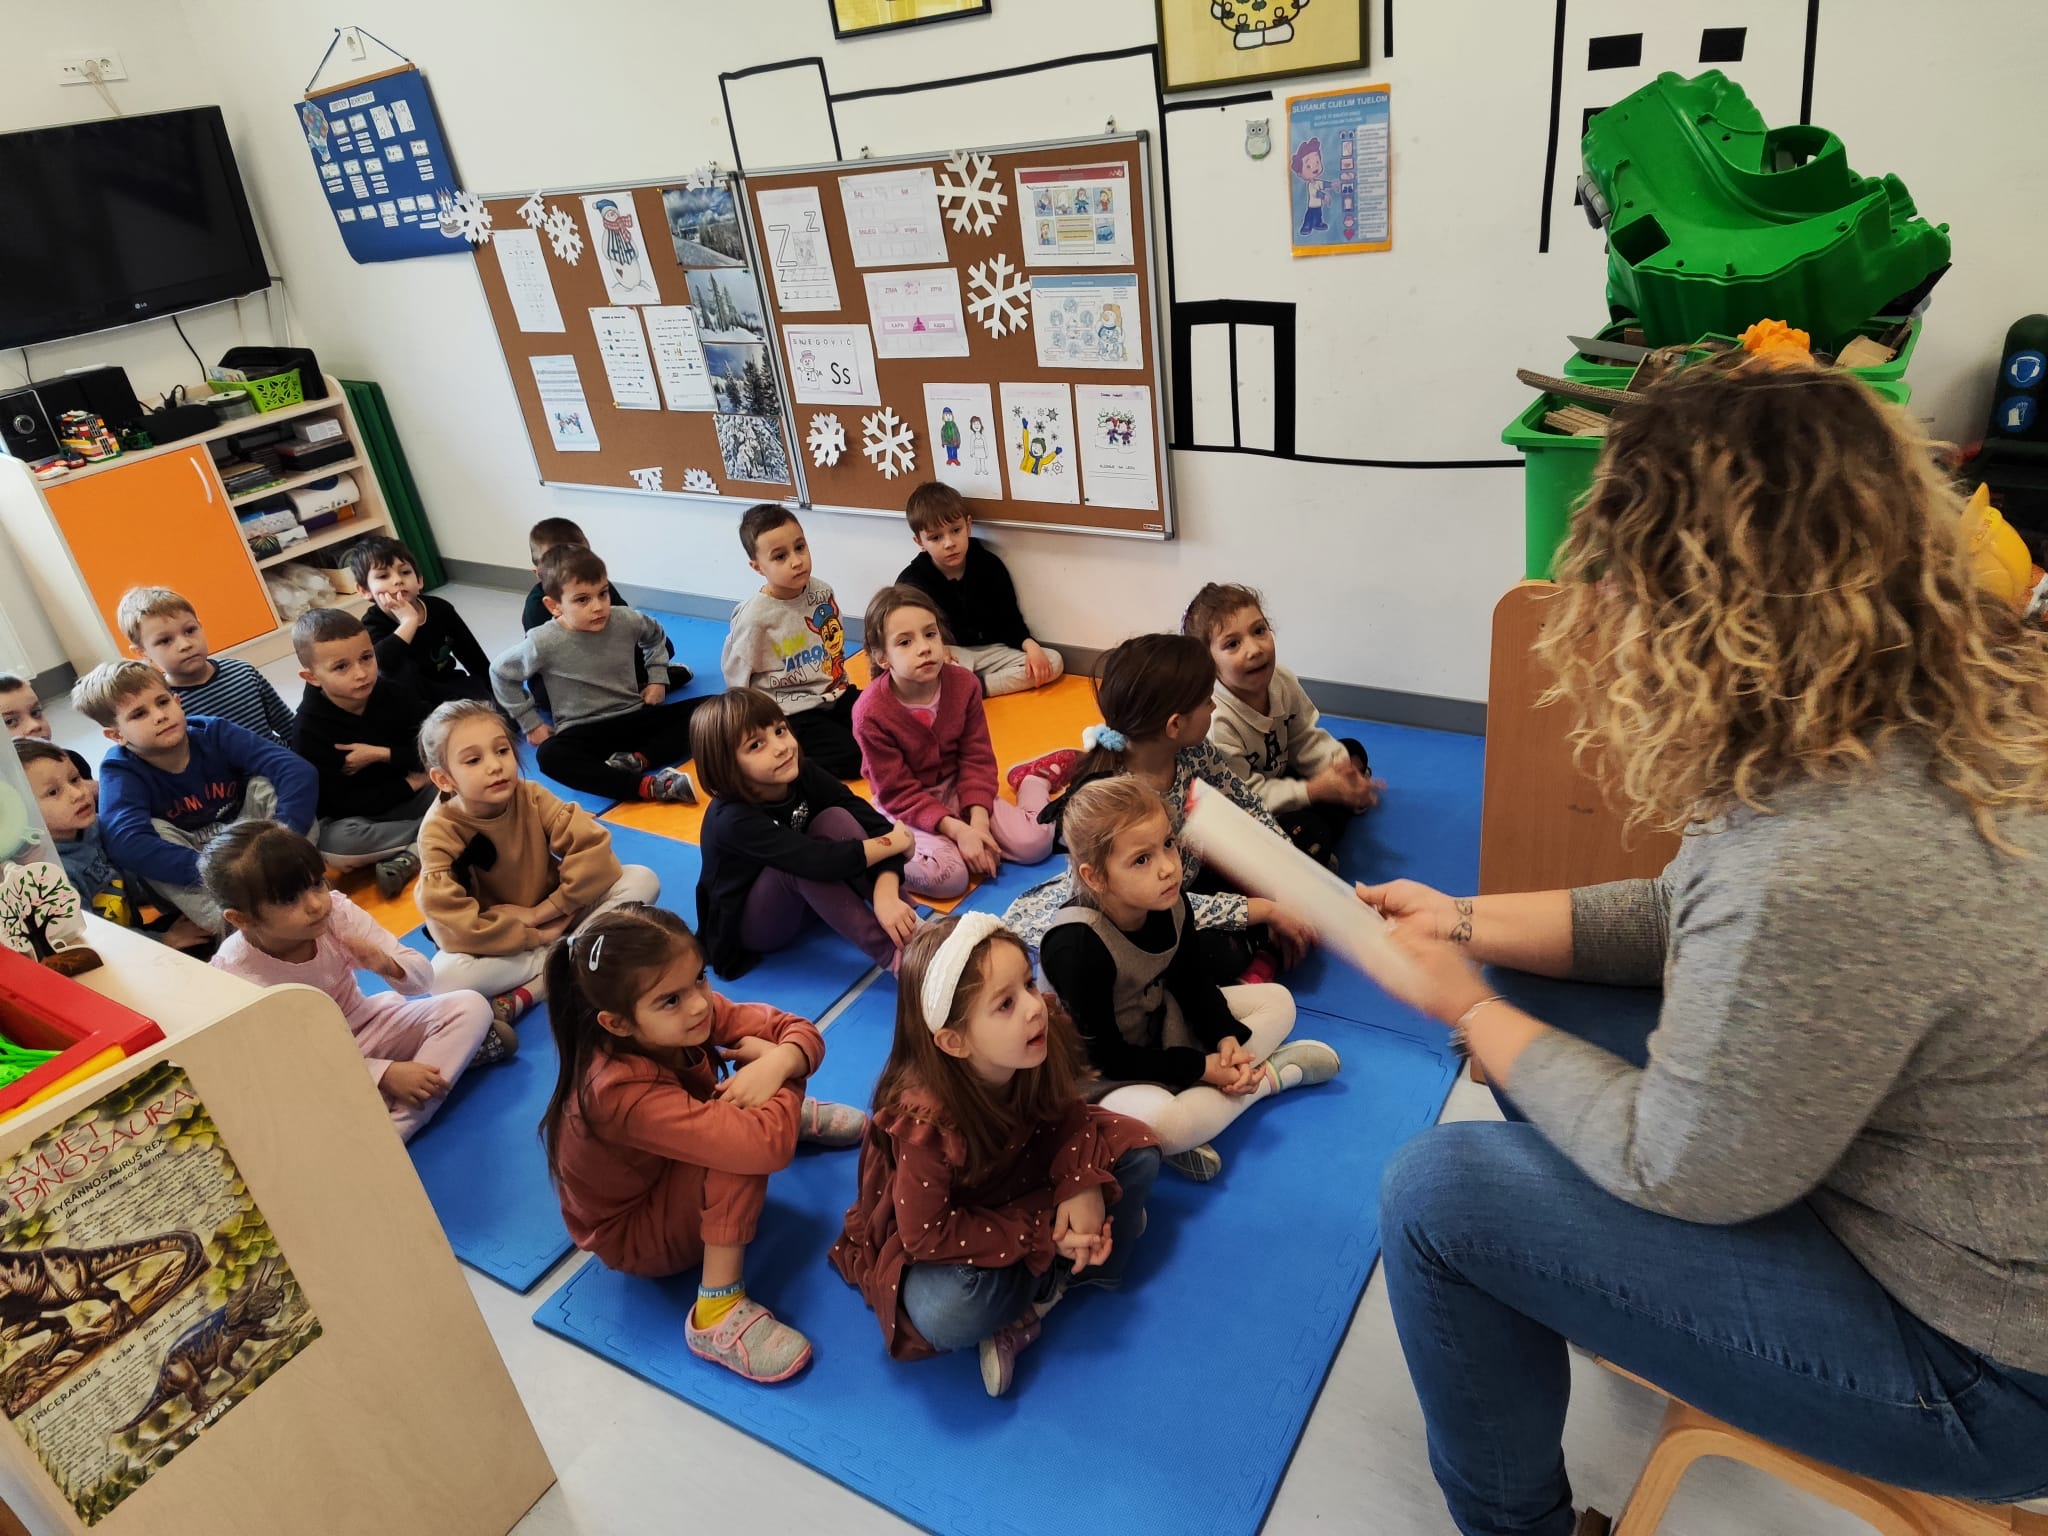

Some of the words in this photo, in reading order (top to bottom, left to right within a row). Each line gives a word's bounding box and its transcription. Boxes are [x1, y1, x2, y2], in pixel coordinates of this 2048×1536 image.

[1357, 95, 1388, 105] TIJELOM
[7, 1119, 100, 1192] SVIJET
[9, 1089, 195, 1213] DINOSAURA
[51, 1152, 143, 1216] TYRANNOSAURUS
[145, 1137, 166, 1155] REX
[29, 1369, 101, 1425] TRICERATOPS
[143, 1319, 168, 1342] poput
[189, 1397, 232, 1436] radost
